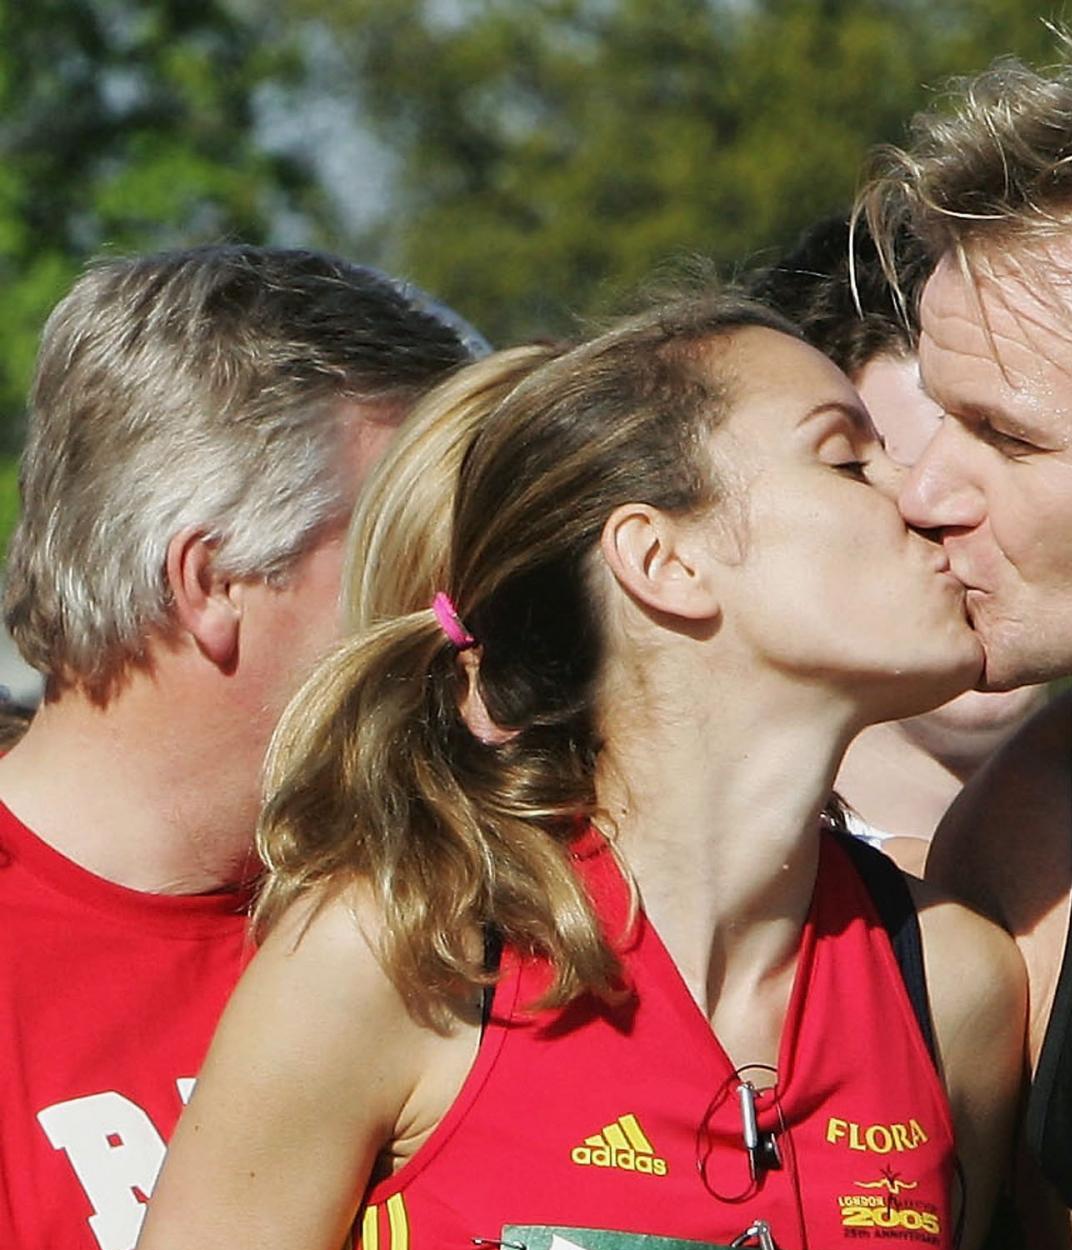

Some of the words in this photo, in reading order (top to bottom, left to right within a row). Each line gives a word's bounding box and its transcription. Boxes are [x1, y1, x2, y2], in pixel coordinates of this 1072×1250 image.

[826, 1117, 928, 1154] FLORA
[571, 1145, 668, 1176] adidas
[838, 1195, 885, 1207] LONDON
[841, 1206, 940, 1235] 2005
